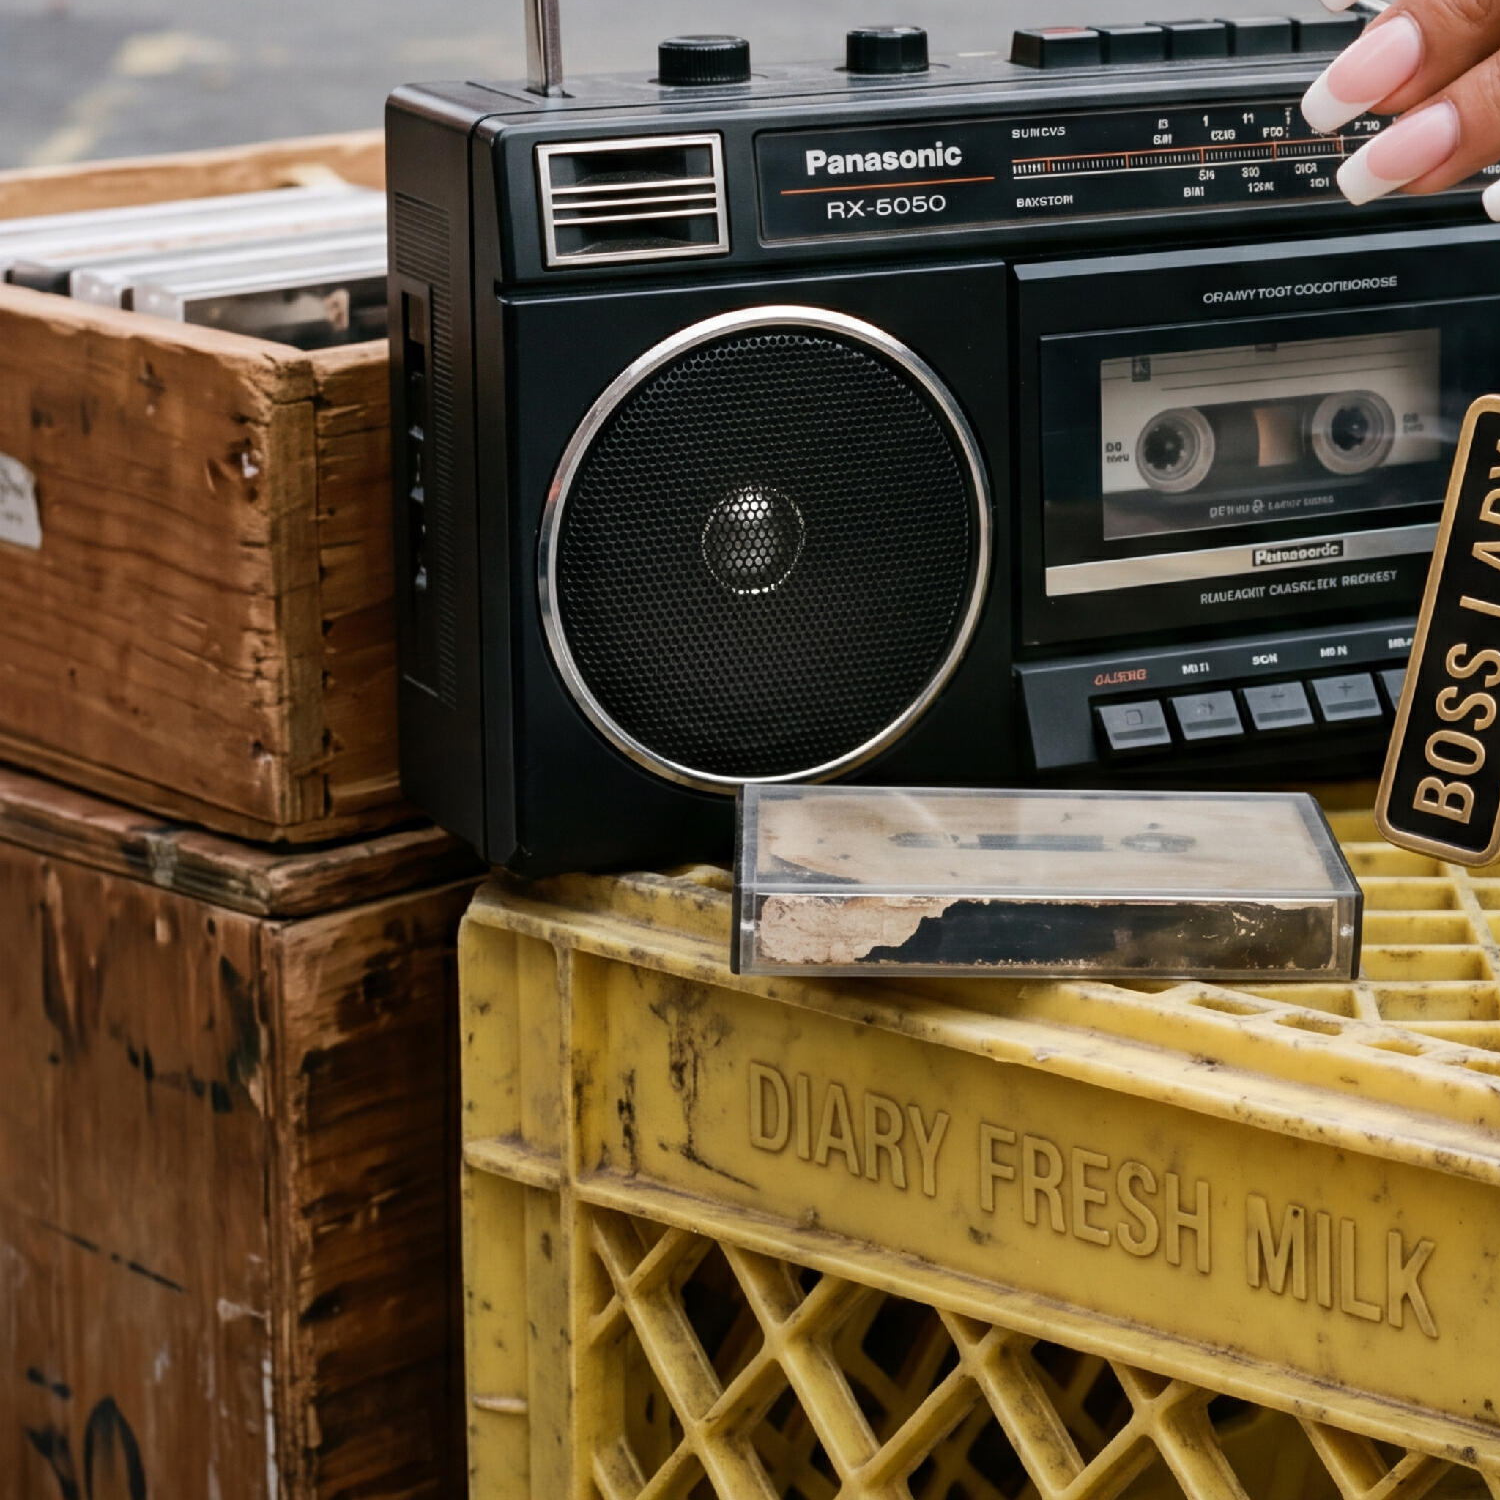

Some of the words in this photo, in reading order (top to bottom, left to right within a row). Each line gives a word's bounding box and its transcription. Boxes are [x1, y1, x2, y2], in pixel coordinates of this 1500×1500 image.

[806, 141, 962, 175] Panasonic
[827, 195, 946, 219] RX-5050
[748, 1061, 950, 1198] DIARY
[978, 1121, 1211, 1274] FRESH
[1246, 1192, 1439, 1339] MILK
